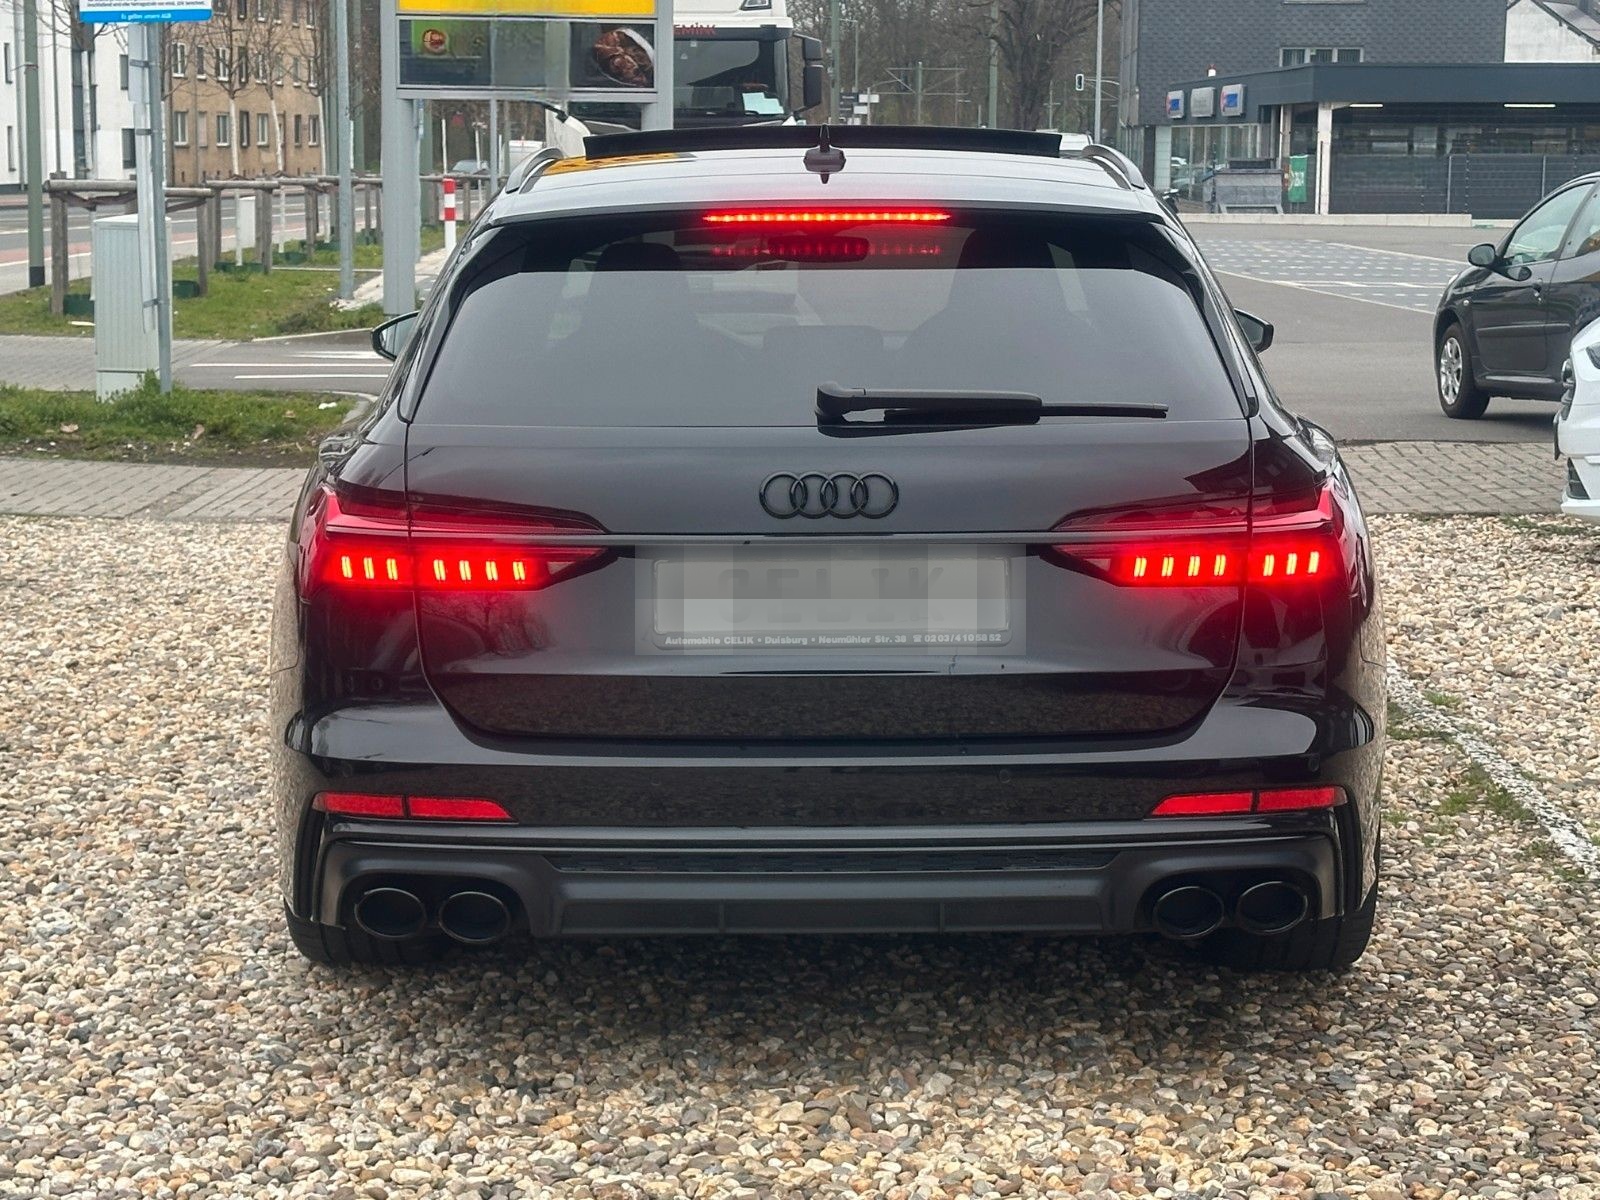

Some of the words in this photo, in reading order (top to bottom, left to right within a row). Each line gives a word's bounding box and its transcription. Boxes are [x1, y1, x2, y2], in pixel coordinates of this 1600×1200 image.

[665, 636, 721, 645] Automobile
[724, 636, 754, 645] CELIK
[764, 636, 808, 647] Duisburg
[818, 634, 872, 644] Neumühler
[874, 635, 893, 644] Str.
